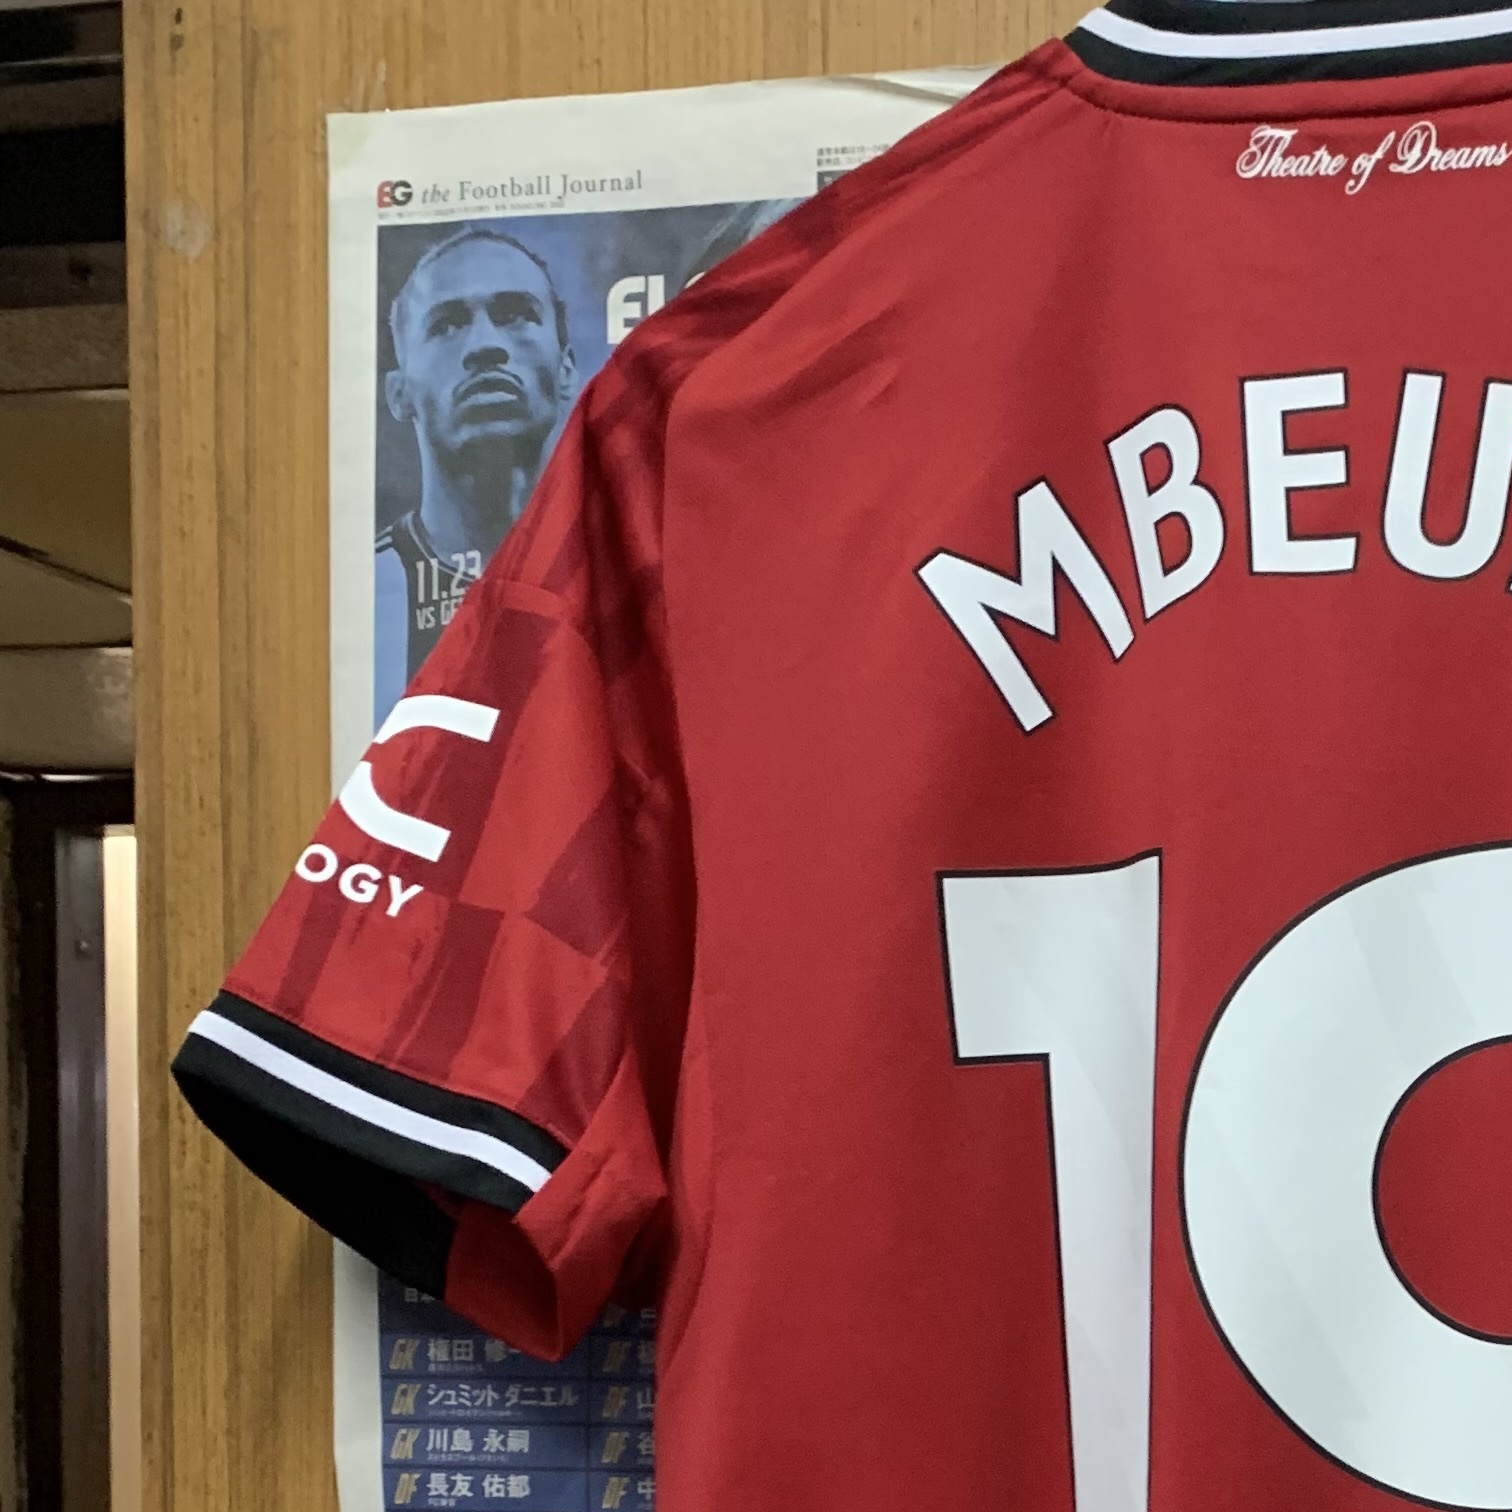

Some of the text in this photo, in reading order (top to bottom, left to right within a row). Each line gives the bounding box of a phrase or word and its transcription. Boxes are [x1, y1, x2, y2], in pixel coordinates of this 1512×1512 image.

[1236, 124, 1348, 179] Theatre
[1345, 131, 1396, 195] of
[421, 184, 450, 203] the
[459, 176, 551, 200] Football
[557, 170, 643, 199] Journal
[295, 843, 424, 918] OGY
[427, 1427, 474, 1453] 川島
[426, 1472, 474, 1498] 長友
